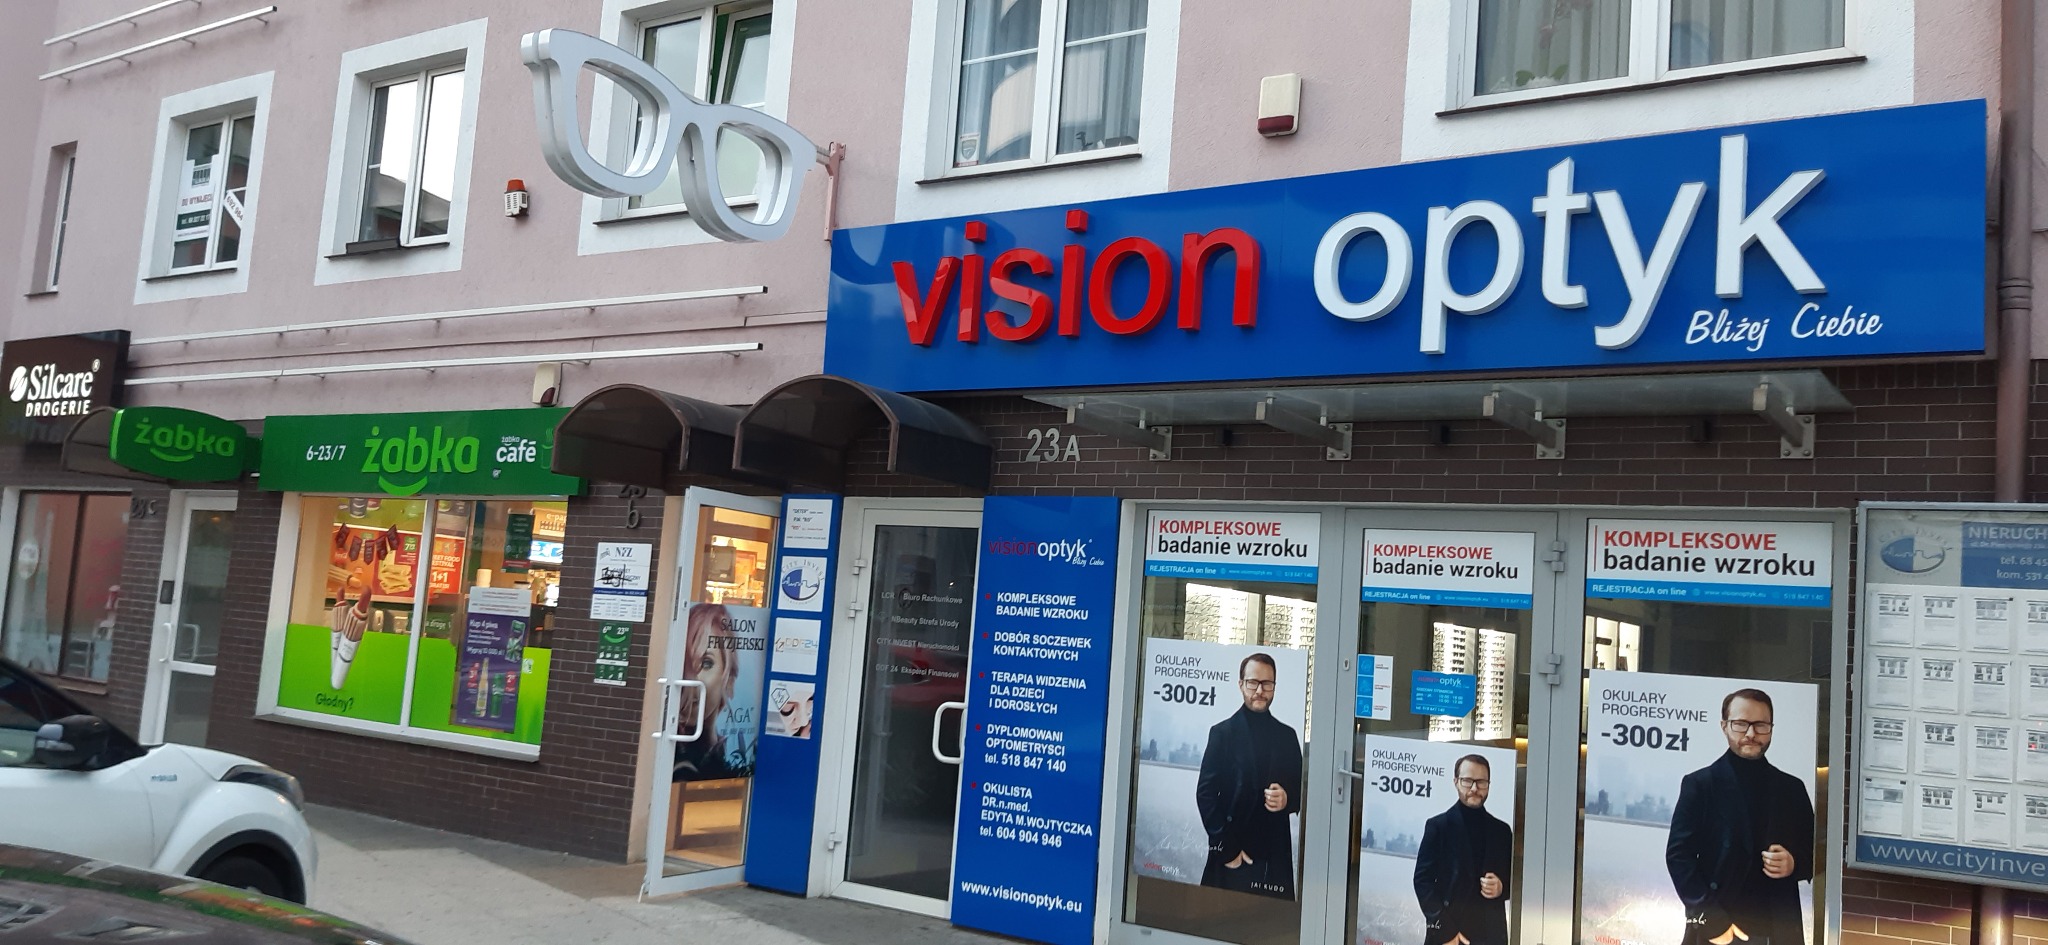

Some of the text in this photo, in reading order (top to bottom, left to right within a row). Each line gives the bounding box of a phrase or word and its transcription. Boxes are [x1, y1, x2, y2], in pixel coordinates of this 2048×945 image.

[892, 133, 1828, 356] vision optyk
[1685, 302, 1883, 352] Bliżej Ciebie
[25, 400, 91, 417] DROGERIE
[134, 417, 236, 457] żabka
[1025, 428, 1080, 462] 23A
[306, 445, 346, 461] 6-23/7
[361, 426, 480, 474] żabka
[496, 440, 537, 463] café
[1159, 520, 1281, 536] KOMPLEKSOWE
[1158, 535, 1308, 557] badanie wzroku
[1604, 530, 1777, 551] KOMPLEKSOWE
[1373, 544, 1493, 560] KOMPLEKSOWE
[2000, 555, 2018, 565] tel.
[2019, 556, 2033, 565] 68
[1149, 565, 1194, 574] REJESTRACJA
[1205, 567, 1217, 575] line
[1373, 558, 1518, 579] badanie wzroku
[1603, 549, 1815, 577] badanie wzroku
[433, 571, 448, 582] 1+1
[1996, 569, 2024, 579] kom.
[2025, 571, 2042, 580] 531
[903, 592, 921, 601] Biuro
[922, 594, 963, 604] Rachunkowe
[1364, 591, 1409, 600] REJESTRACJA
[1592, 584, 1655, 595] REJESTRACJA
[1670, 586, 1687, 596] line
[997, 592, 1077, 606] KOMPLEKSOWE
[996, 605, 1089, 620] BADANIE WZROKU
[721, 618, 756, 633] SALON
[891, 615, 960, 629] NBeauty Strefa Urody
[707, 635, 765, 652] FRYZJERSKI
[994, 630, 1092, 649] DOBÓR SOCZEWEK
[993, 645, 1079, 662] KONTAKTOWYCH
[1155, 654, 1202, 667] OKULARY
[890, 665, 898, 673] 24
[901, 666, 927, 676] Eksperci
[928, 668, 960, 678] Finansowi
[1154, 666, 1230, 682] PROGRESYWNE
[991, 671, 1087, 690] TERAPIA WIDZENIA
[990, 685, 1045, 699] DLA DZIECI
[1602, 689, 1667, 704] OKULARY
[315, 693, 354, 712] Głodny?
[989, 698, 1058, 715] I DOROSŁYCH
[1601, 703, 1708, 723] PROGRESYWNE
[987, 723, 1063, 742] DYPLOMOWANI
[985, 753, 1066, 773] tel. 518 847 140
[1372, 749, 1417, 762] OKULARY
[1371, 760, 1445, 777] PROGRESYWNE
[983, 782, 1033, 799] OKULISTA
[982, 796, 1030, 813] DR.n.med.
[981, 809, 1014, 824] EDYTA
[980, 825, 1062, 848] tel. 604 904 946
[1871, 843, 2047, 876] www.cityinve
[961, 881, 1083, 913] www.visionoptyk.eu
